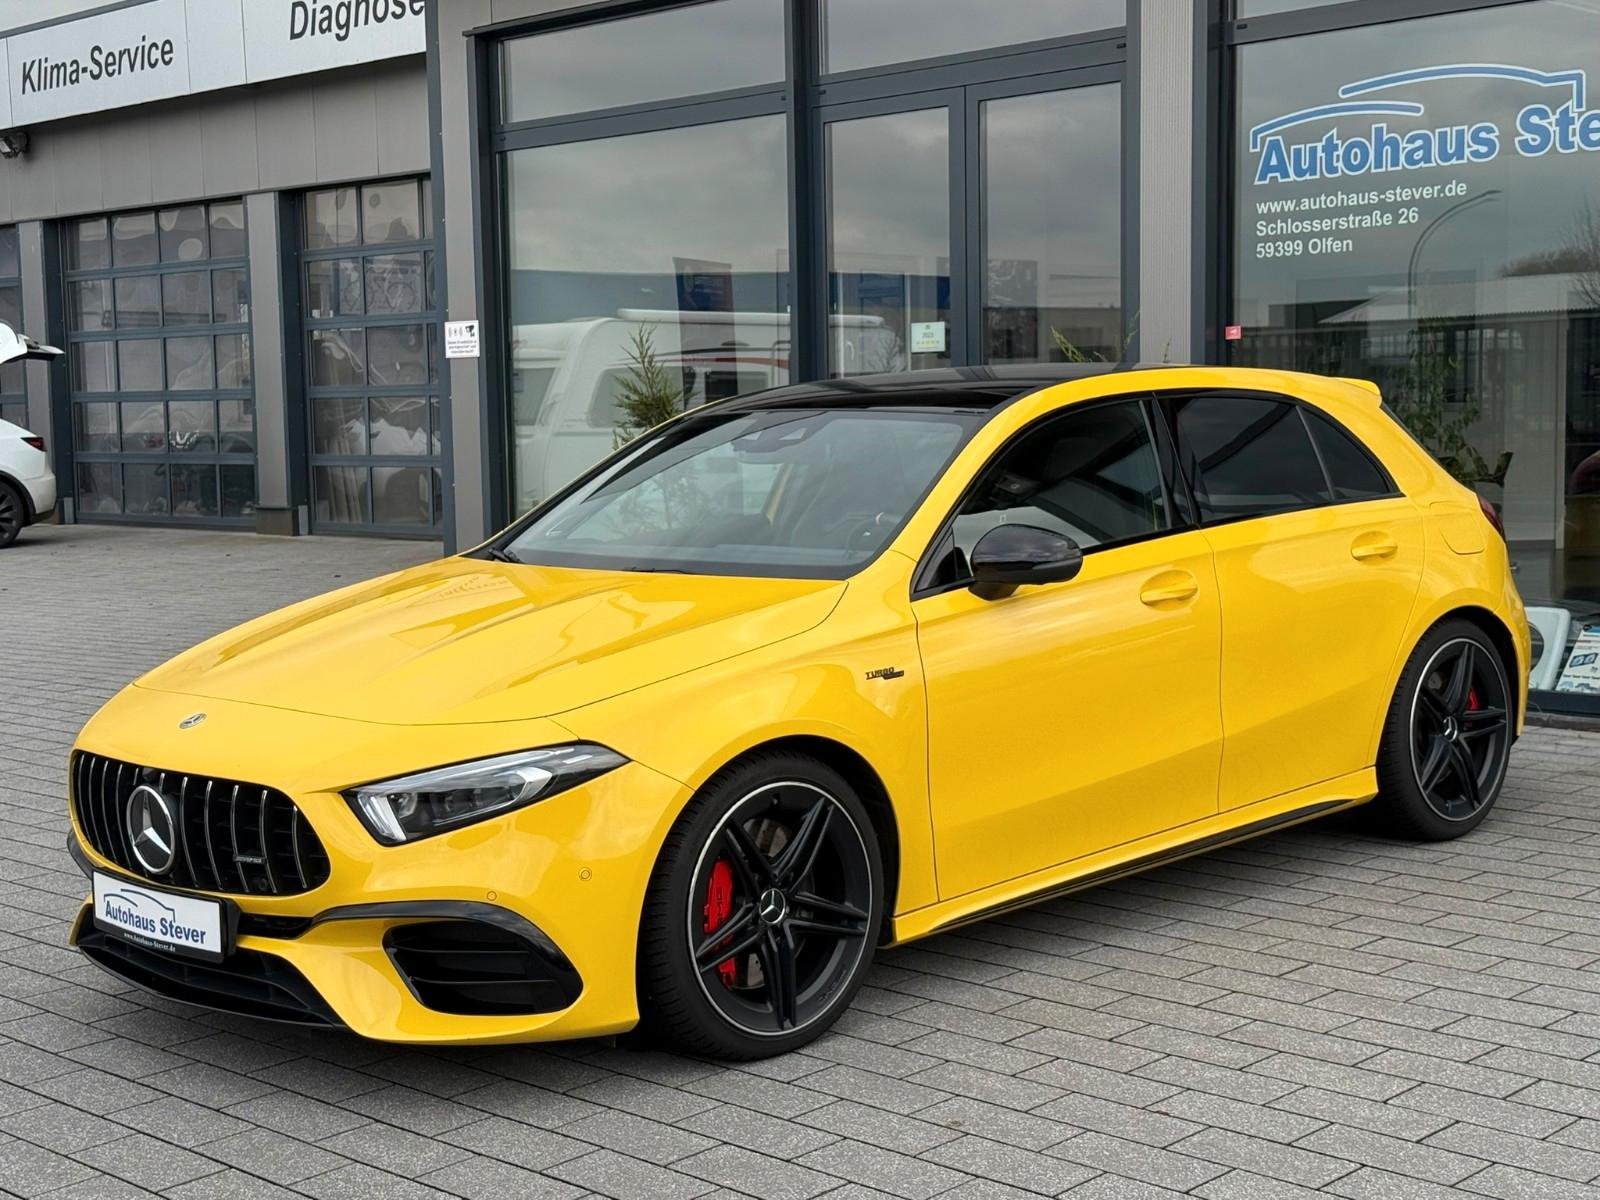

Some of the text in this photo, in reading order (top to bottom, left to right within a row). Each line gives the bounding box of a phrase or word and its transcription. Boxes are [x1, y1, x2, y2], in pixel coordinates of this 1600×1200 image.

[289, 0, 425, 42] Diagnose
[21, 35, 174, 95] Klima-Service
[1254, 122, 1500, 185] Autohaus
[1255, 180, 1468, 214] www.autohaus-stever.de
[1255, 207, 1419, 238] Schlosserstraße 26
[1255, 237, 1353, 259] 59399 Olfen
[105, 900, 206, 944] Autohaus Stever
